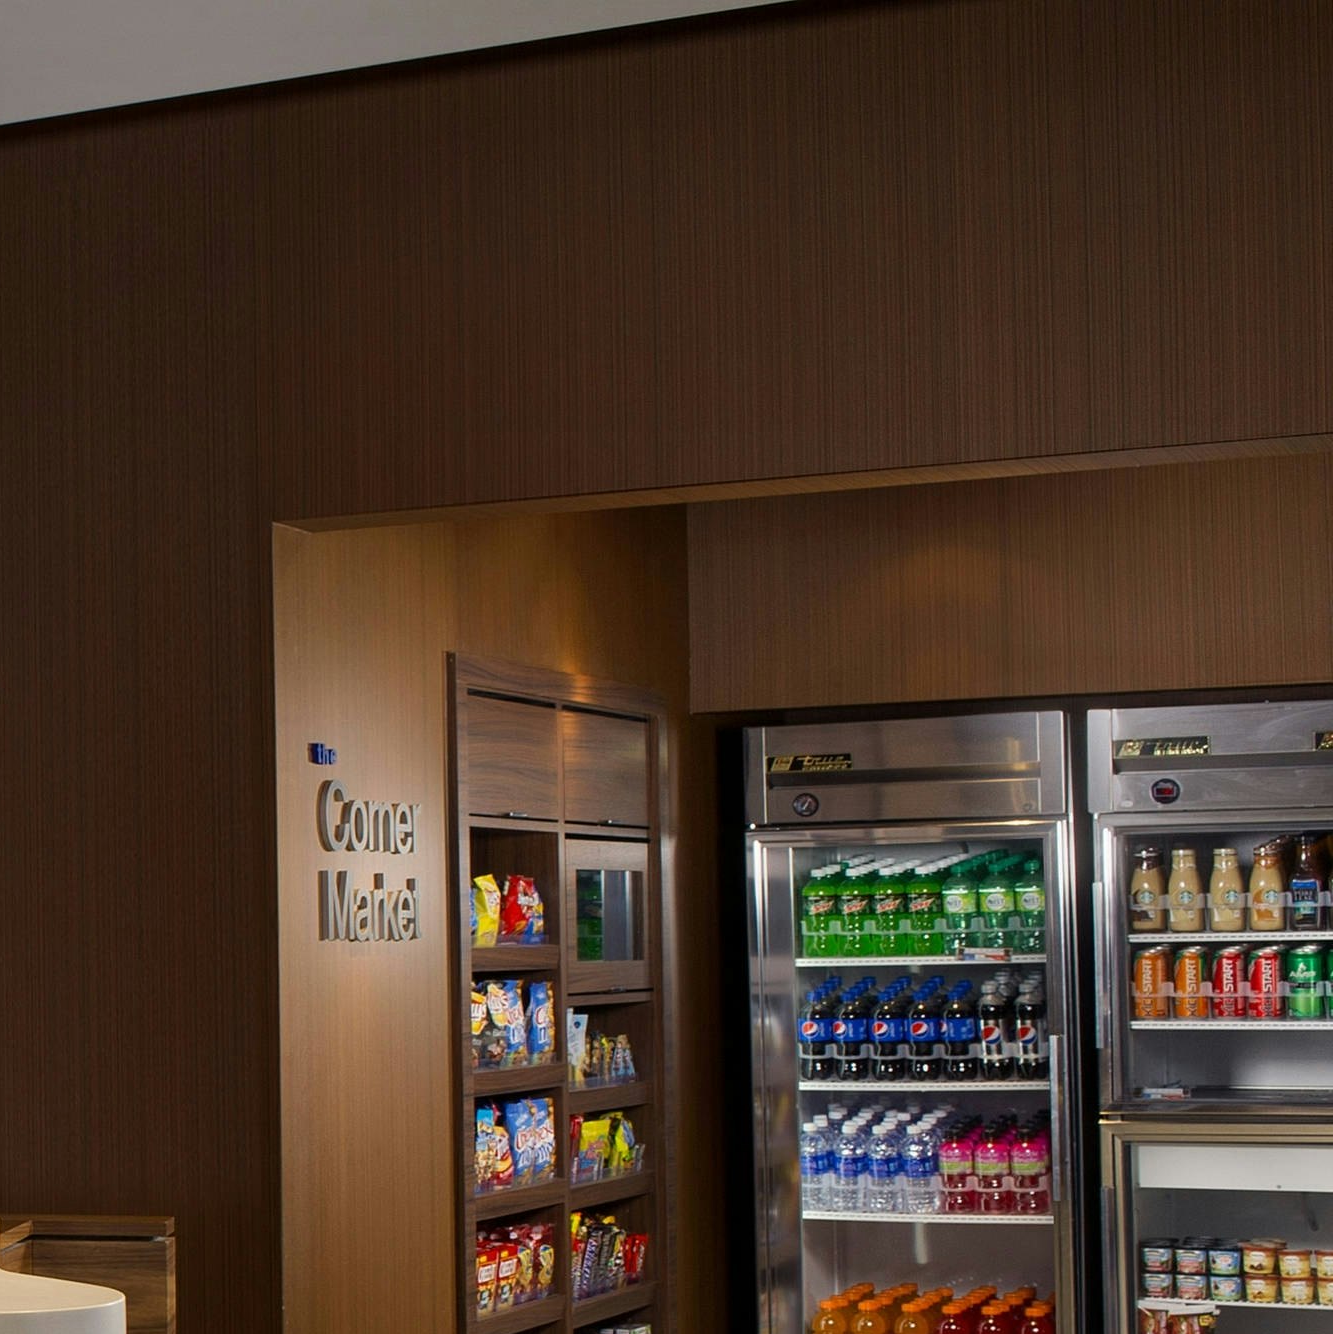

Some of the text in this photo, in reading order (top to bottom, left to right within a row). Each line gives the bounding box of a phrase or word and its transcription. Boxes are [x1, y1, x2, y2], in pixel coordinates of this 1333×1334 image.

[308, 742, 337, 765] the
[317, 779, 421, 855] Corner
[318, 870, 422, 942] Market
